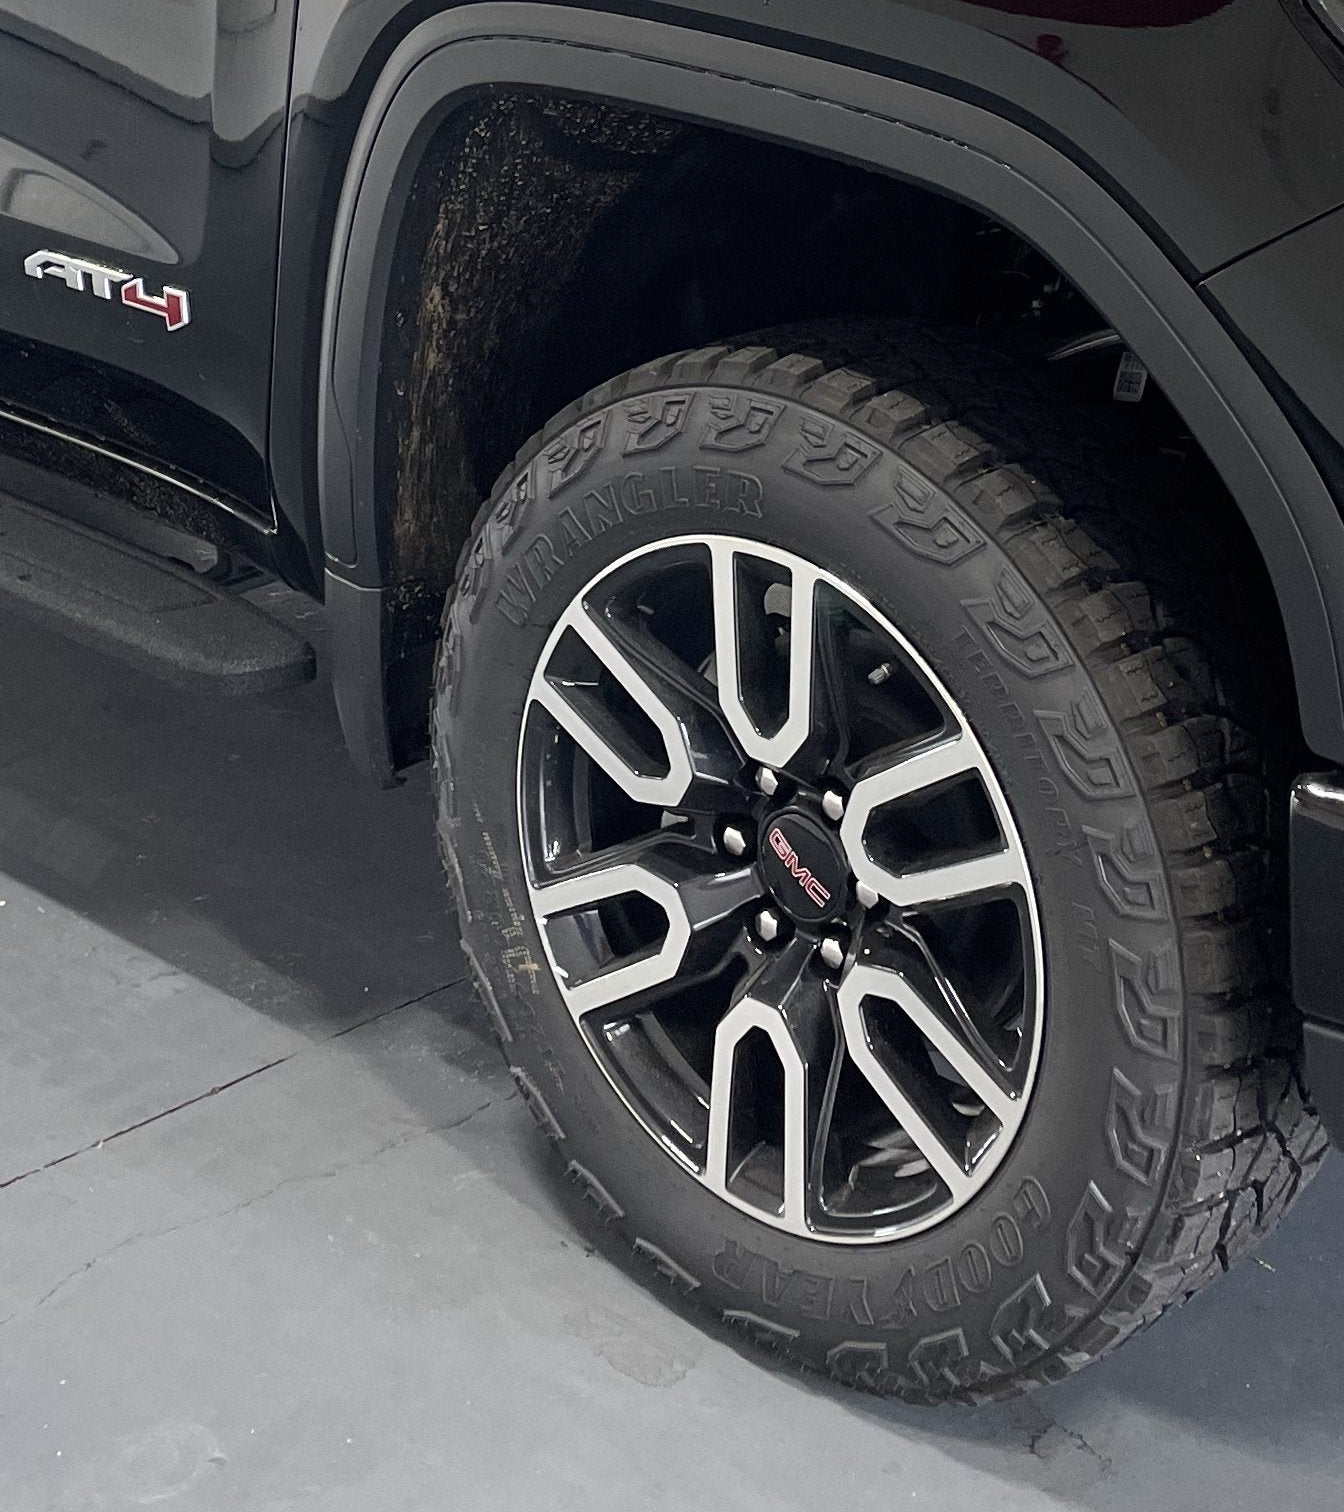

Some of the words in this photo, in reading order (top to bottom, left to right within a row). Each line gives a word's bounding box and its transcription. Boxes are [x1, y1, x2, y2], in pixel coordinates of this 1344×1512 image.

[24, 249, 192, 332] AT4
[495, 465, 764, 627] WRANGLER
[768, 827, 831, 908] GMC
[712, 1175, 1051, 1329] GOODYEAR
